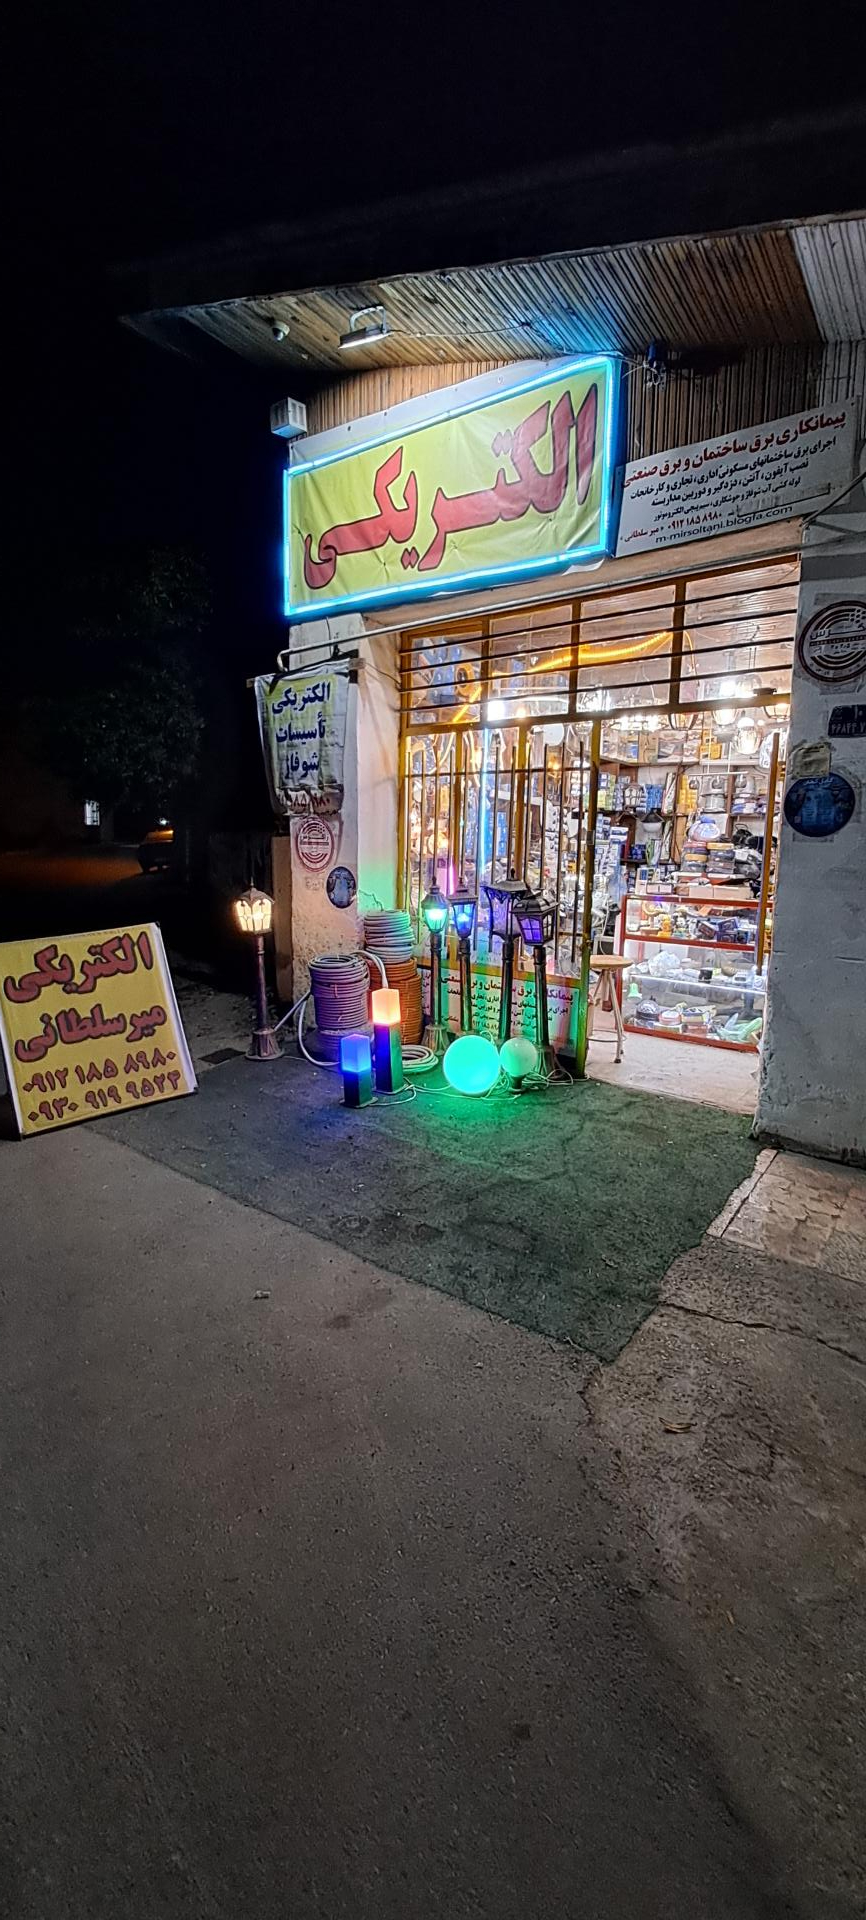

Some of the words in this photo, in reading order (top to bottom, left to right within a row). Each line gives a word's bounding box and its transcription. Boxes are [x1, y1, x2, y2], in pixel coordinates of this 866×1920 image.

[776, 412, 846, 445] پیمانکاری
[692, 438, 747, 468] ساختمان
[749, 432, 775, 453] برق
[793, 446, 809, 459] برق
[809, 436, 836, 455] اجرای
[659, 457, 682, 478] برق
[684, 459, 691, 471] و
[788, 458, 809, 473] نصب
[304, 382, 598, 589] الکتریکی
[623, 465, 658, 489] صنعتی
[670, 474, 693, 491] تجاری
[630, 482, 666, 499] کارخانجات
[651, 493, 681, 507] مداربسته
[681, 489, 706, 502] دوربین
[668, 519, 684, 531] ۰۹۱۲
[686, 515, 701, 526] ۱۸۵
[702, 511, 722, 523] ۸۹۸۰
[272, 682, 331, 714] الکتریکی
[275, 711, 326, 744] تأسیسات
[4, 931, 154, 1003] الکتریکی
[14, 1003, 126, 1063] سلطانی
[125, 1005, 168, 1043] میر
[22, 1067, 69, 1093] ۰۹۱۲
[75, 1058, 119, 1085] ۱۸۵
[124, 1048, 177, 1074] ۸۹۸۰
[85, 1085, 122, 1109] ۹۱۹
